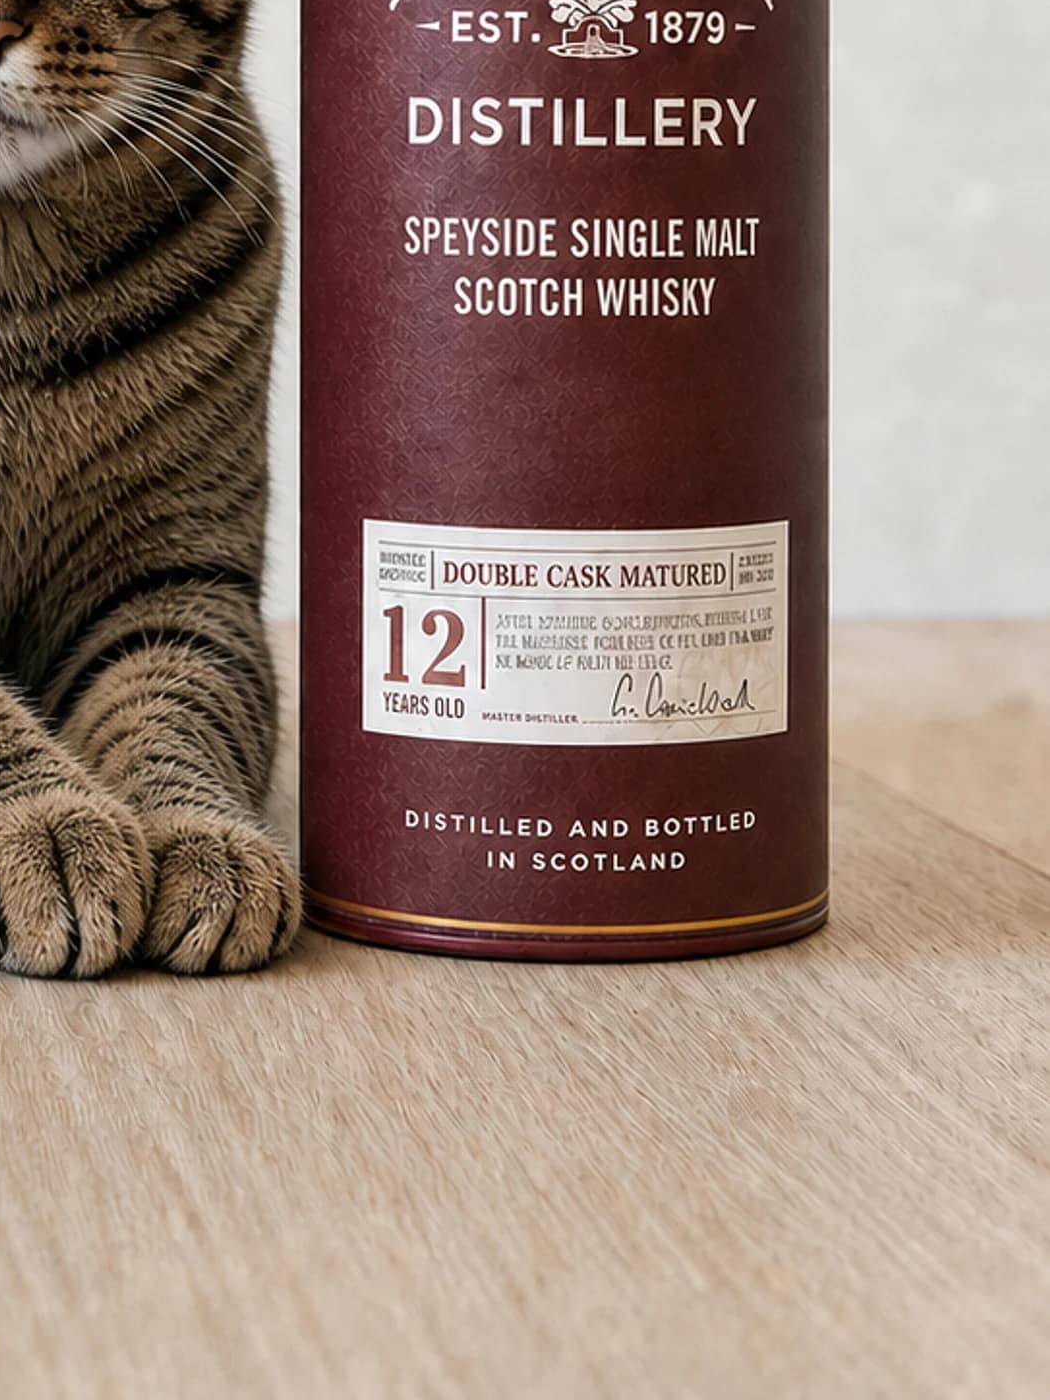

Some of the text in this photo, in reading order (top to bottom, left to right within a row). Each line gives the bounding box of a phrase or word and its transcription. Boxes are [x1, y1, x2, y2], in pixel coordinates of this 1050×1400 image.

[451, 10, 726, 44] EST. 1879
[407, 96, 757, 147] DISTILLERY
[403, 215, 760, 259] SPEYSIDE SINGLE MALT
[453, 276, 717, 317] SCOTCH WHISKY
[443, 561, 539, 588] DOUBLE
[547, 564, 613, 589] CASK
[620, 562, 727, 588] MATURED
[382, 604, 467, 689] 12
[382, 691, 466, 719] YEARS OLD
[405, 809, 757, 838] DISTILLED AND BOTTLED
[487, 850, 687, 872] IN SCOTLAND
